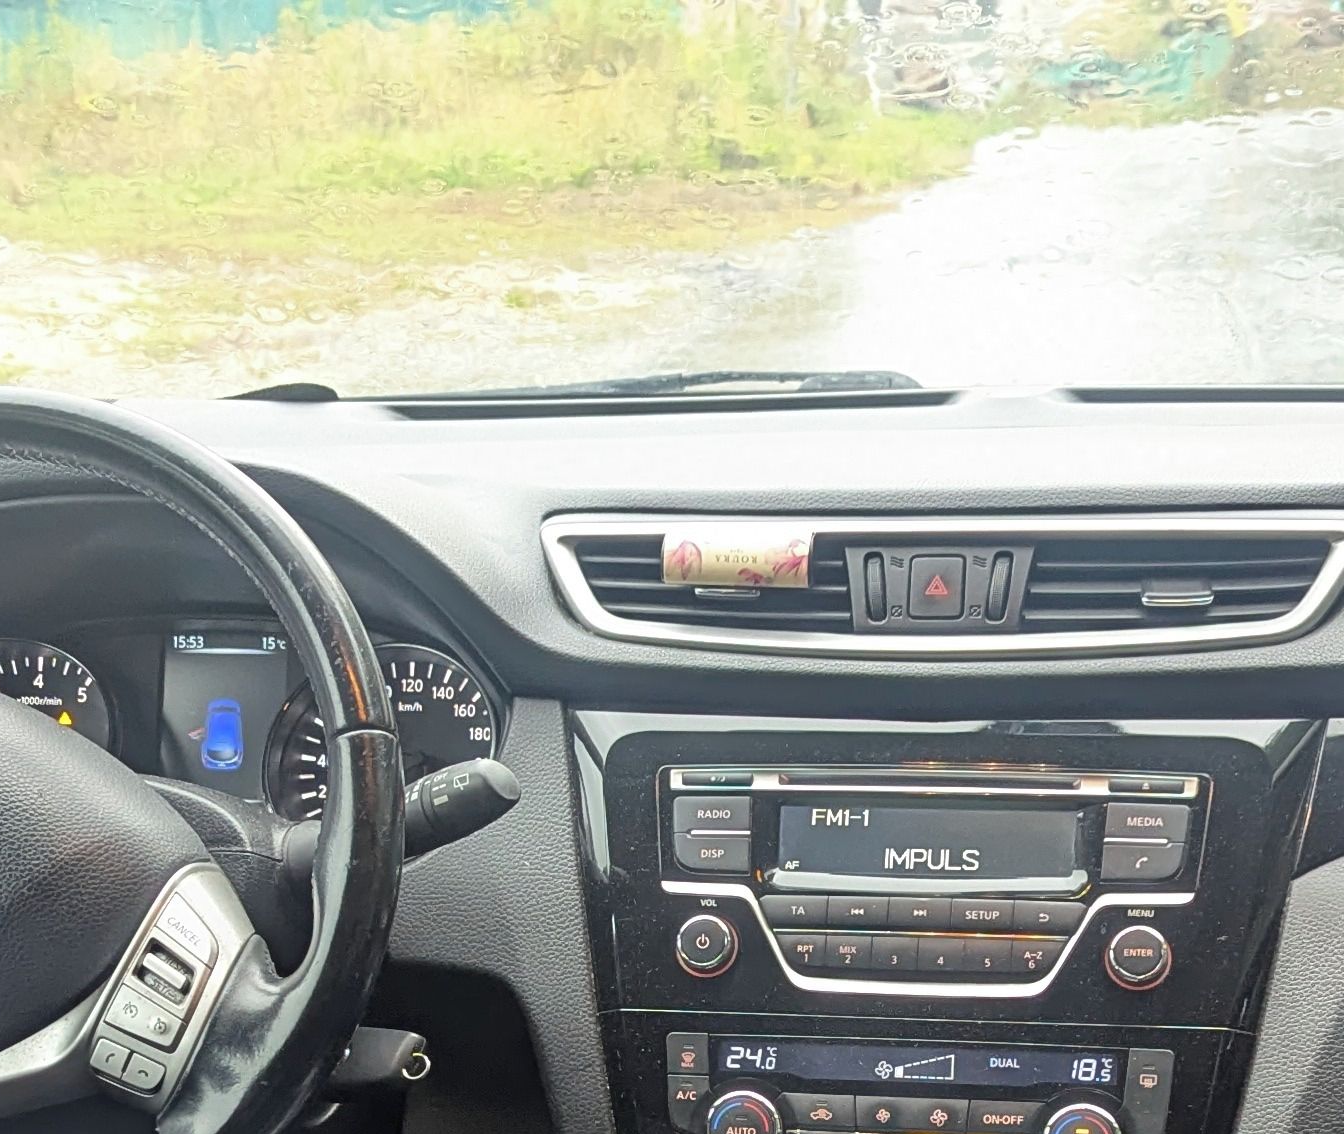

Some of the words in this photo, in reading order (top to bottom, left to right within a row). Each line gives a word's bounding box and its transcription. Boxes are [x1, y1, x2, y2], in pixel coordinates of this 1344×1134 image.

[173, 635, 204, 649] 15:53
[262, 636, 276, 650] 15
[33, 673, 44, 688] 4
[401, 679, 424, 693] 120
[77, 687, 88, 703] 5
[432, 686, 454, 700] 140
[398, 702, 423, 712] km/h
[454, 704, 476, 718] 160
[469, 727, 491, 741] 180
[697, 809, 731, 819] RADIO
[811, 808, 870, 827] FM1-1
[1126, 816, 1164, 827] MEDIA
[700, 849, 725, 859] DISP
[884, 847, 980, 871] IMPULS
[784, 860, 800, 870] AF
[700, 899, 718, 908] VOL
[791, 906, 806, 915] TA
[965, 910, 1000, 920] SETUP
[1127, 908, 1155, 918] MENU
[167, 916, 202, 947] CANCEL
[797, 944, 813, 953] RPT
[1123, 948, 1153, 957] ENTER
[803, 954, 809, 963] 1
[844, 955, 851, 964] 2
[891, 956, 897, 965] 3
[1023, 951, 1043, 960] A-Z
[937, 957, 944, 966] 4
[984, 959, 991, 968] 5
[1028, 960, 1035, 970] 6
[989, 1057, 1020, 1069] DUAL
[676, 1091, 697, 1101] A/C
[982, 1114, 1024, 1125] ON-OFF
